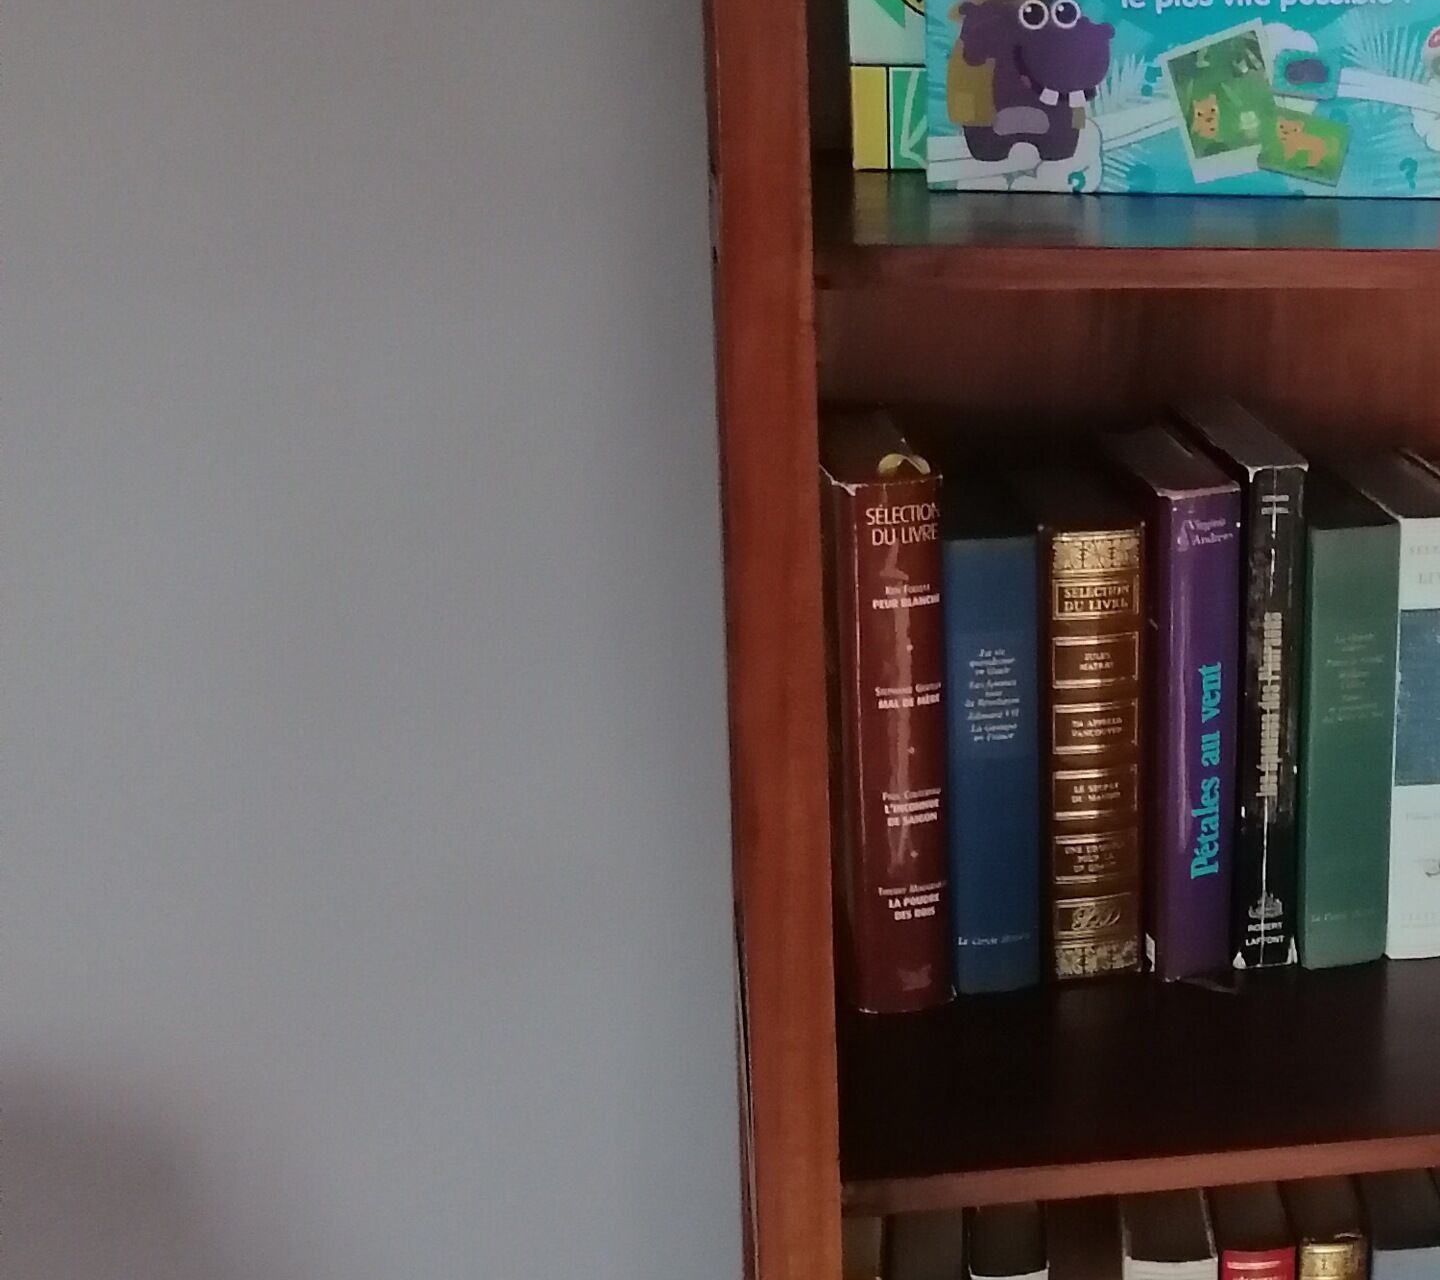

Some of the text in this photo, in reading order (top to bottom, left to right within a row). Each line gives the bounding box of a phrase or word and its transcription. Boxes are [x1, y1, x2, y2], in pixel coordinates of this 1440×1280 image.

[872, 522, 938, 546] DU LIVRE
[1064, 600, 1084, 612] DU
[1191, 662, 1222, 880] Pétales au vent
